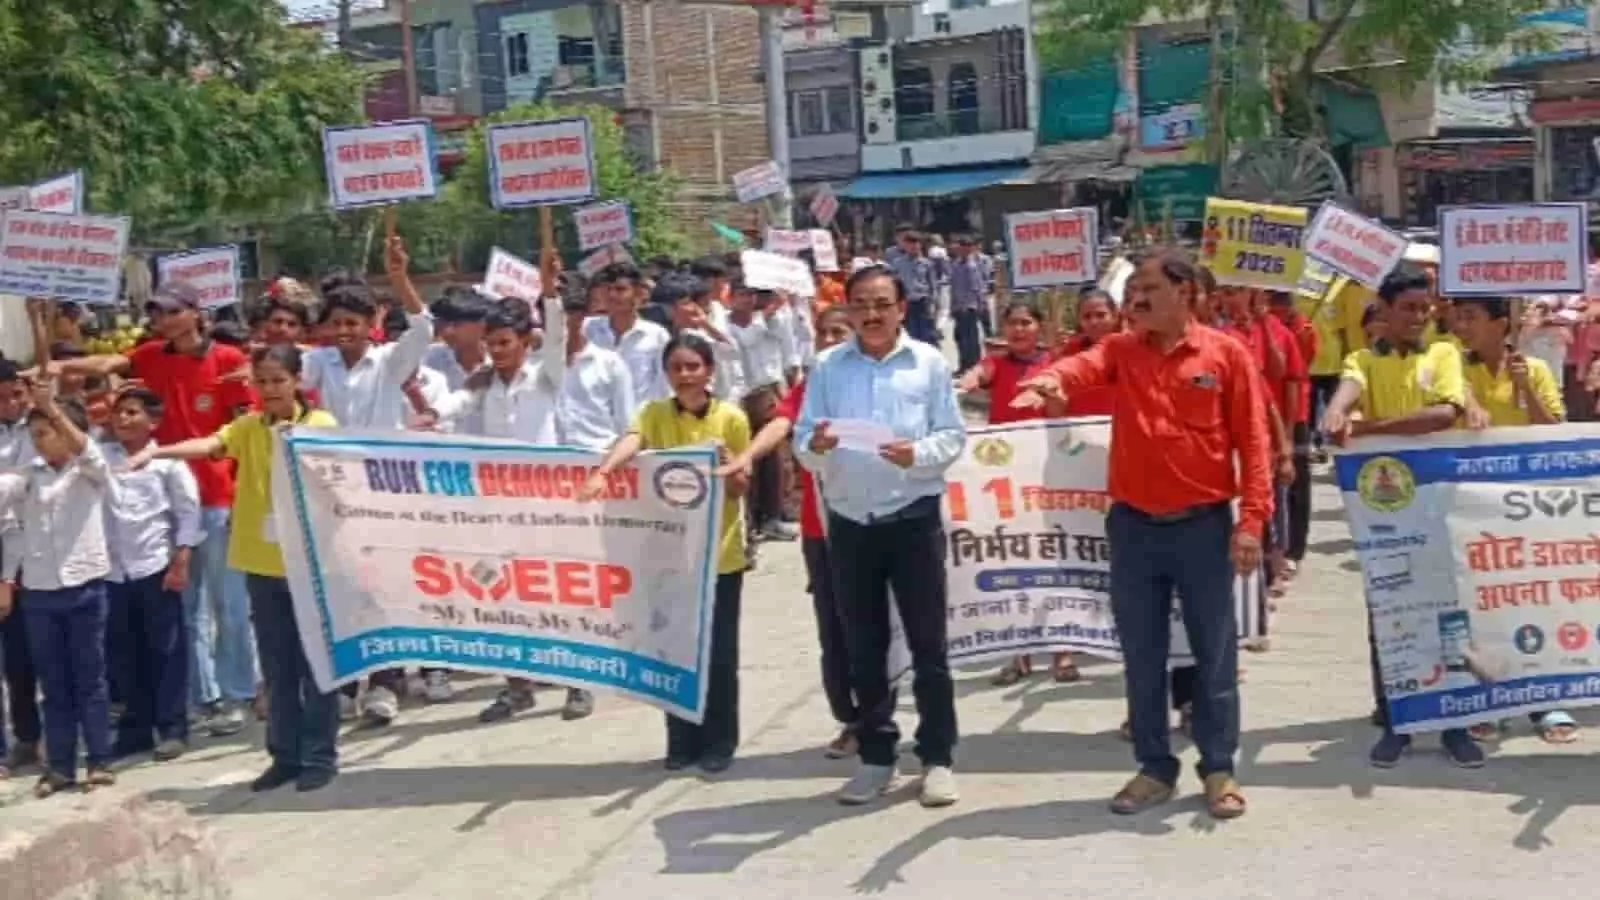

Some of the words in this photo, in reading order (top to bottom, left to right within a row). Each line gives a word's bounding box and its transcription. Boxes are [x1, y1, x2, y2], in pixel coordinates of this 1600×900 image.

[364, 457, 422, 495] RUN
[423, 460, 476, 497] FOR
[478, 463, 640, 499] DEMOCRCY
[452, 511, 502, 524] Heart
[950, 524, 1031, 567] निर्भय
[1034, 522, 1068, 557] हो
[412, 553, 633, 608] SWEEP
[1475, 579, 1553, 611] अपना
[538, 610, 570, 633] My
[358, 633, 429, 660] जिला
[431, 633, 521, 662] निर्वाचन
